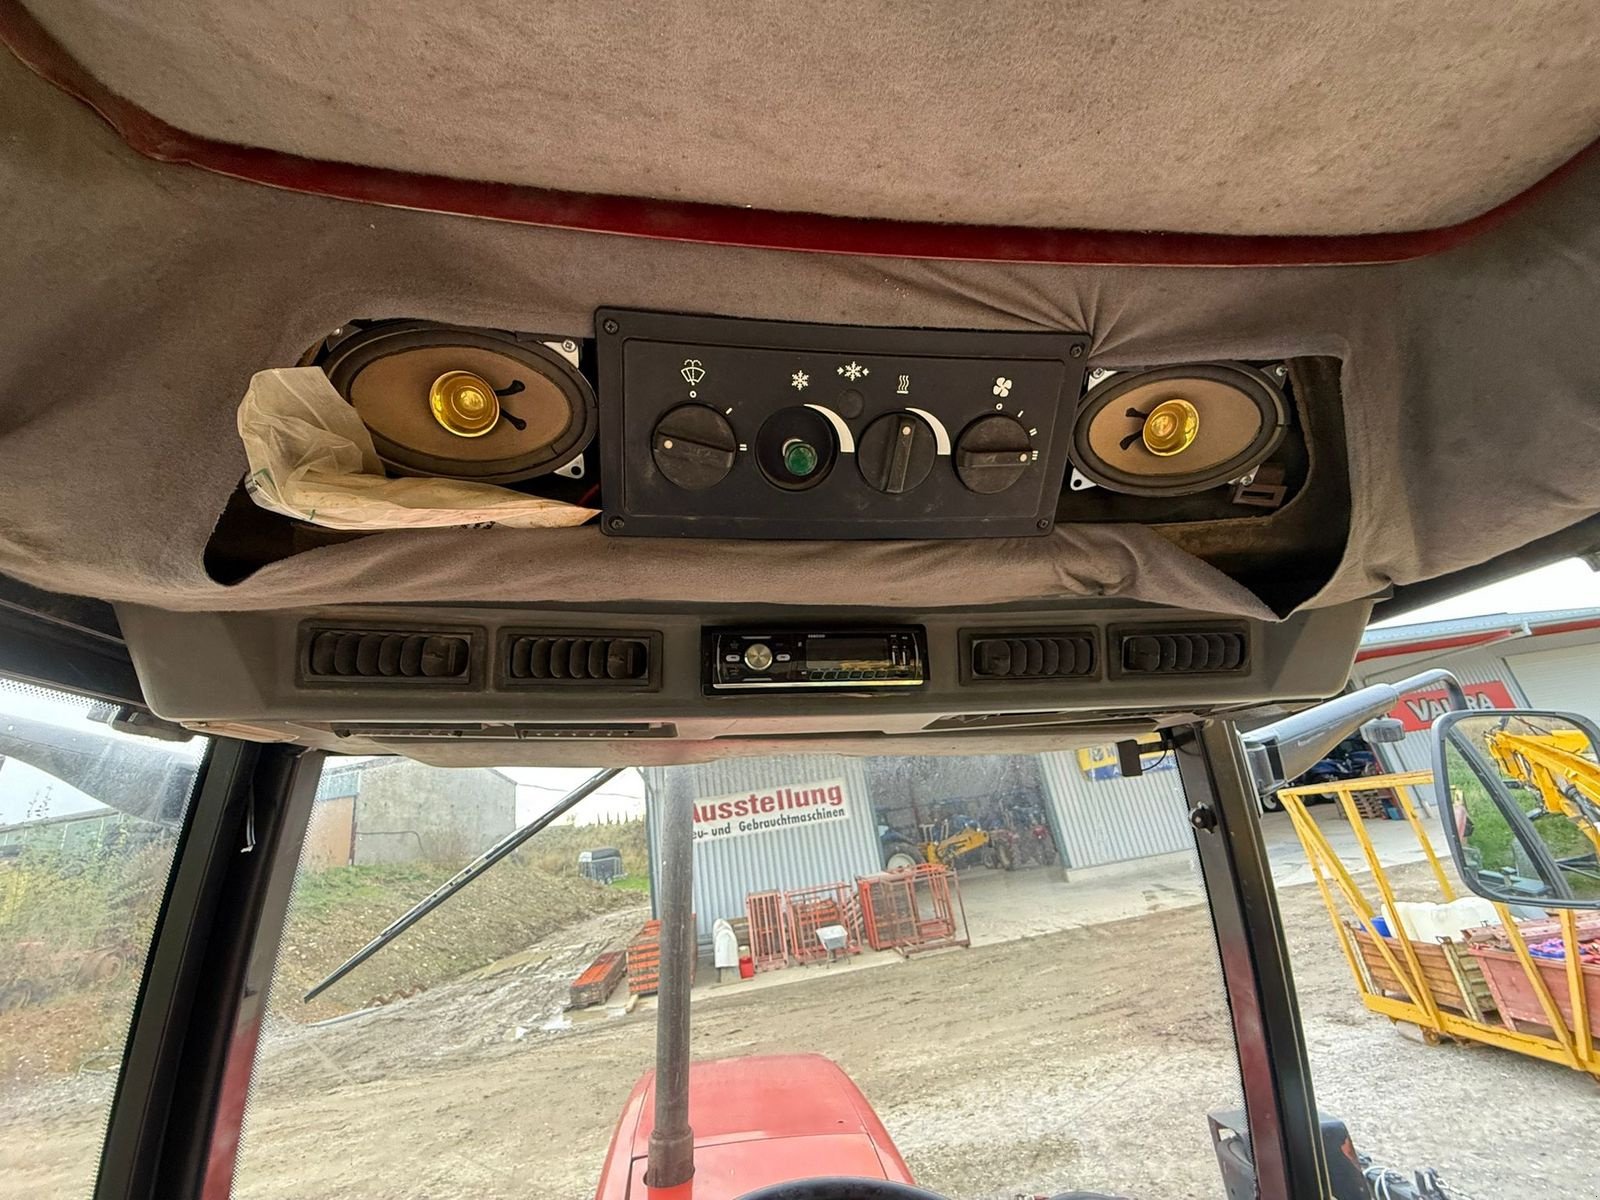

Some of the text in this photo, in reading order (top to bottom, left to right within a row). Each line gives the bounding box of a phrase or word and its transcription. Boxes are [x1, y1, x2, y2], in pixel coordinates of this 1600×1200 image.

[1405, 692, 1495, 722] VALRA
[690, 807, 846, 840] eu- und Gebrauchtmaschinen
